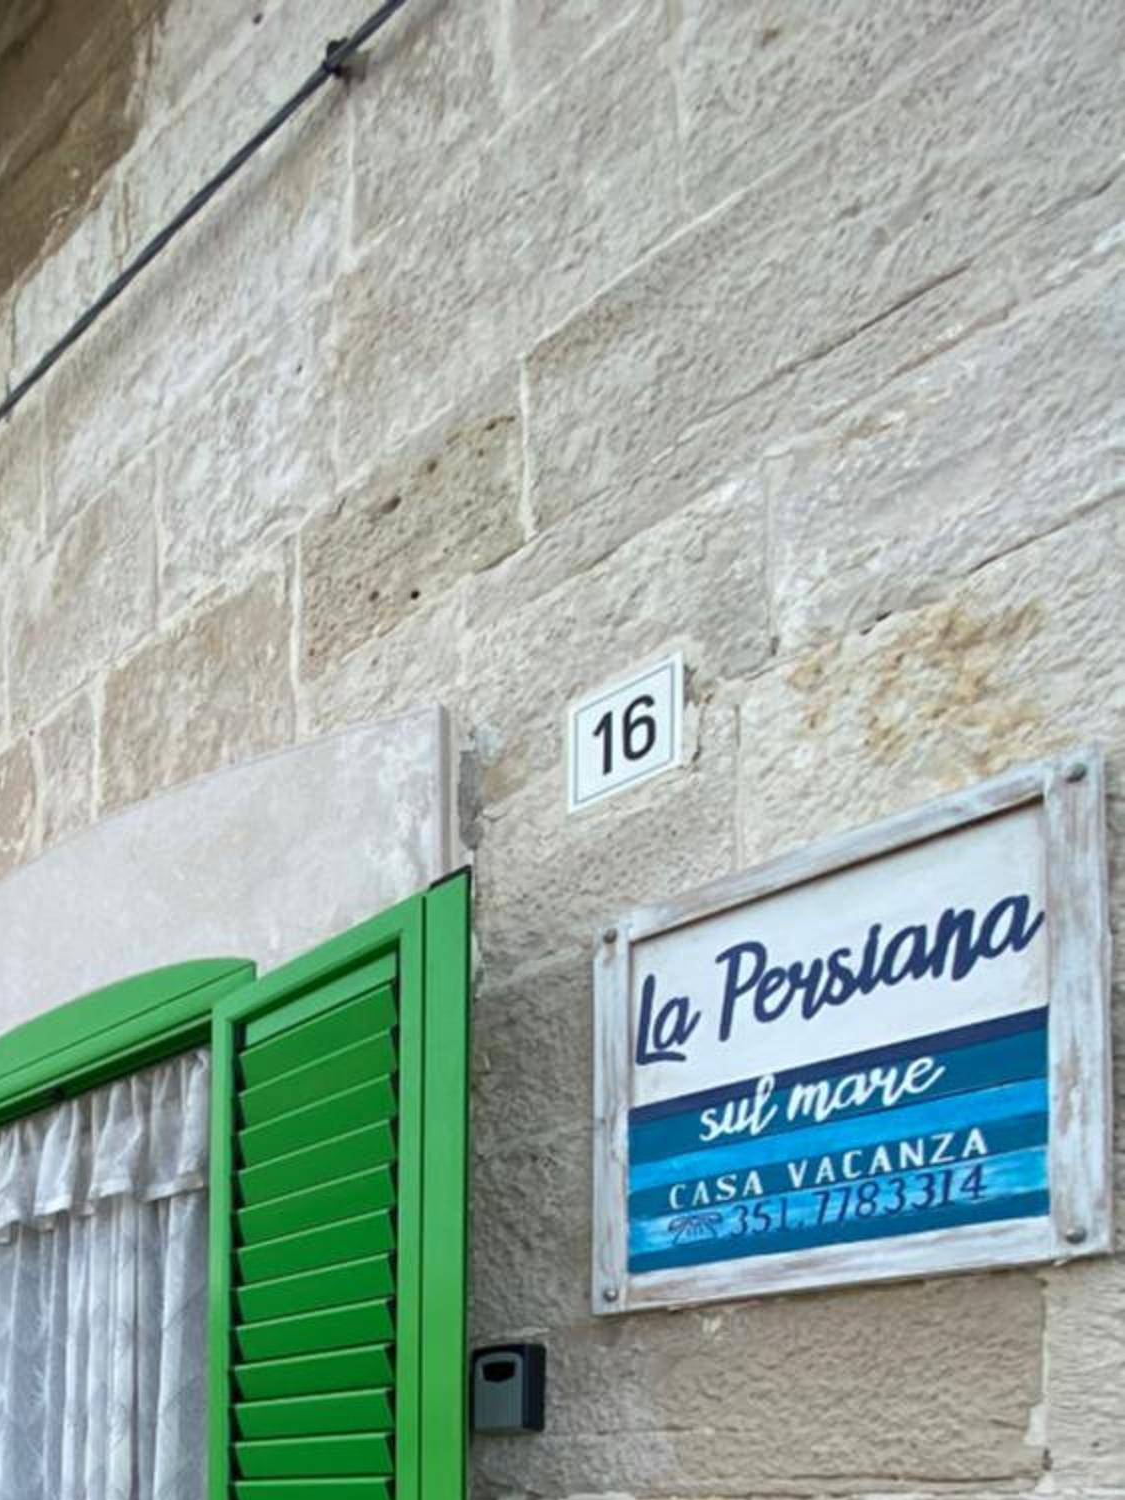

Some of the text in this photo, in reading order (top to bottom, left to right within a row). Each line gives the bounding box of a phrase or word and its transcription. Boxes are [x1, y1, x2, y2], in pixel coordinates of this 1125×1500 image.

[592, 694, 656, 776] 16
[636, 894, 1046, 1065] La Persiana
[699, 1056, 946, 1142] sul mare
[668, 1127, 989, 1210] CASA VACANZA
